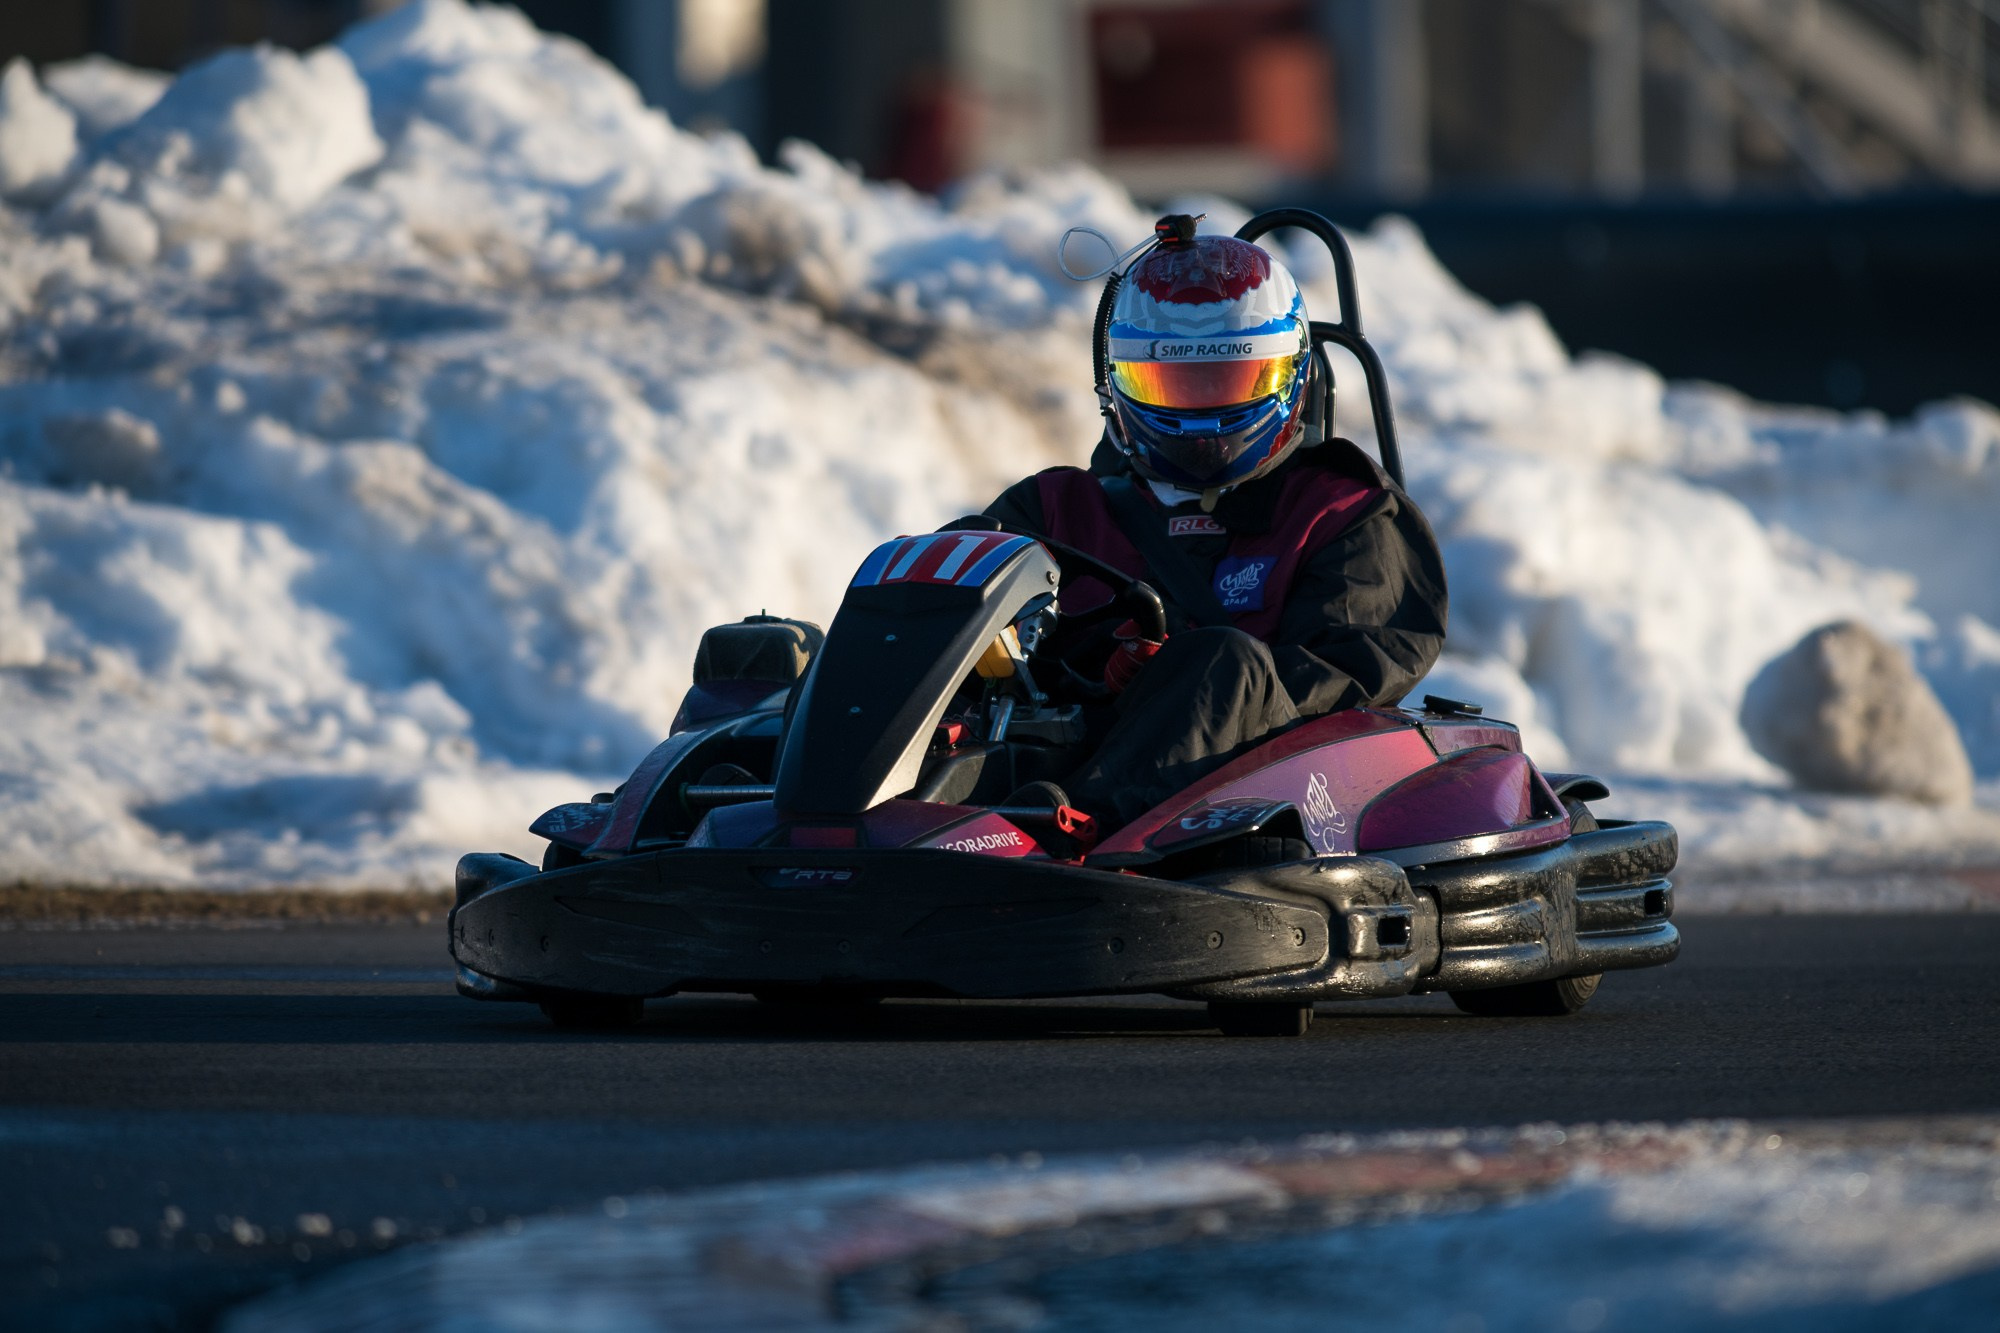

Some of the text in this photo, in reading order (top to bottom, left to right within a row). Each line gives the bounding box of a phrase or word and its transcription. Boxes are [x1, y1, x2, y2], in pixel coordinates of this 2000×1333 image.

[1161, 343, 1253, 357] SMP RACING
[886, 534, 988, 580] 11
